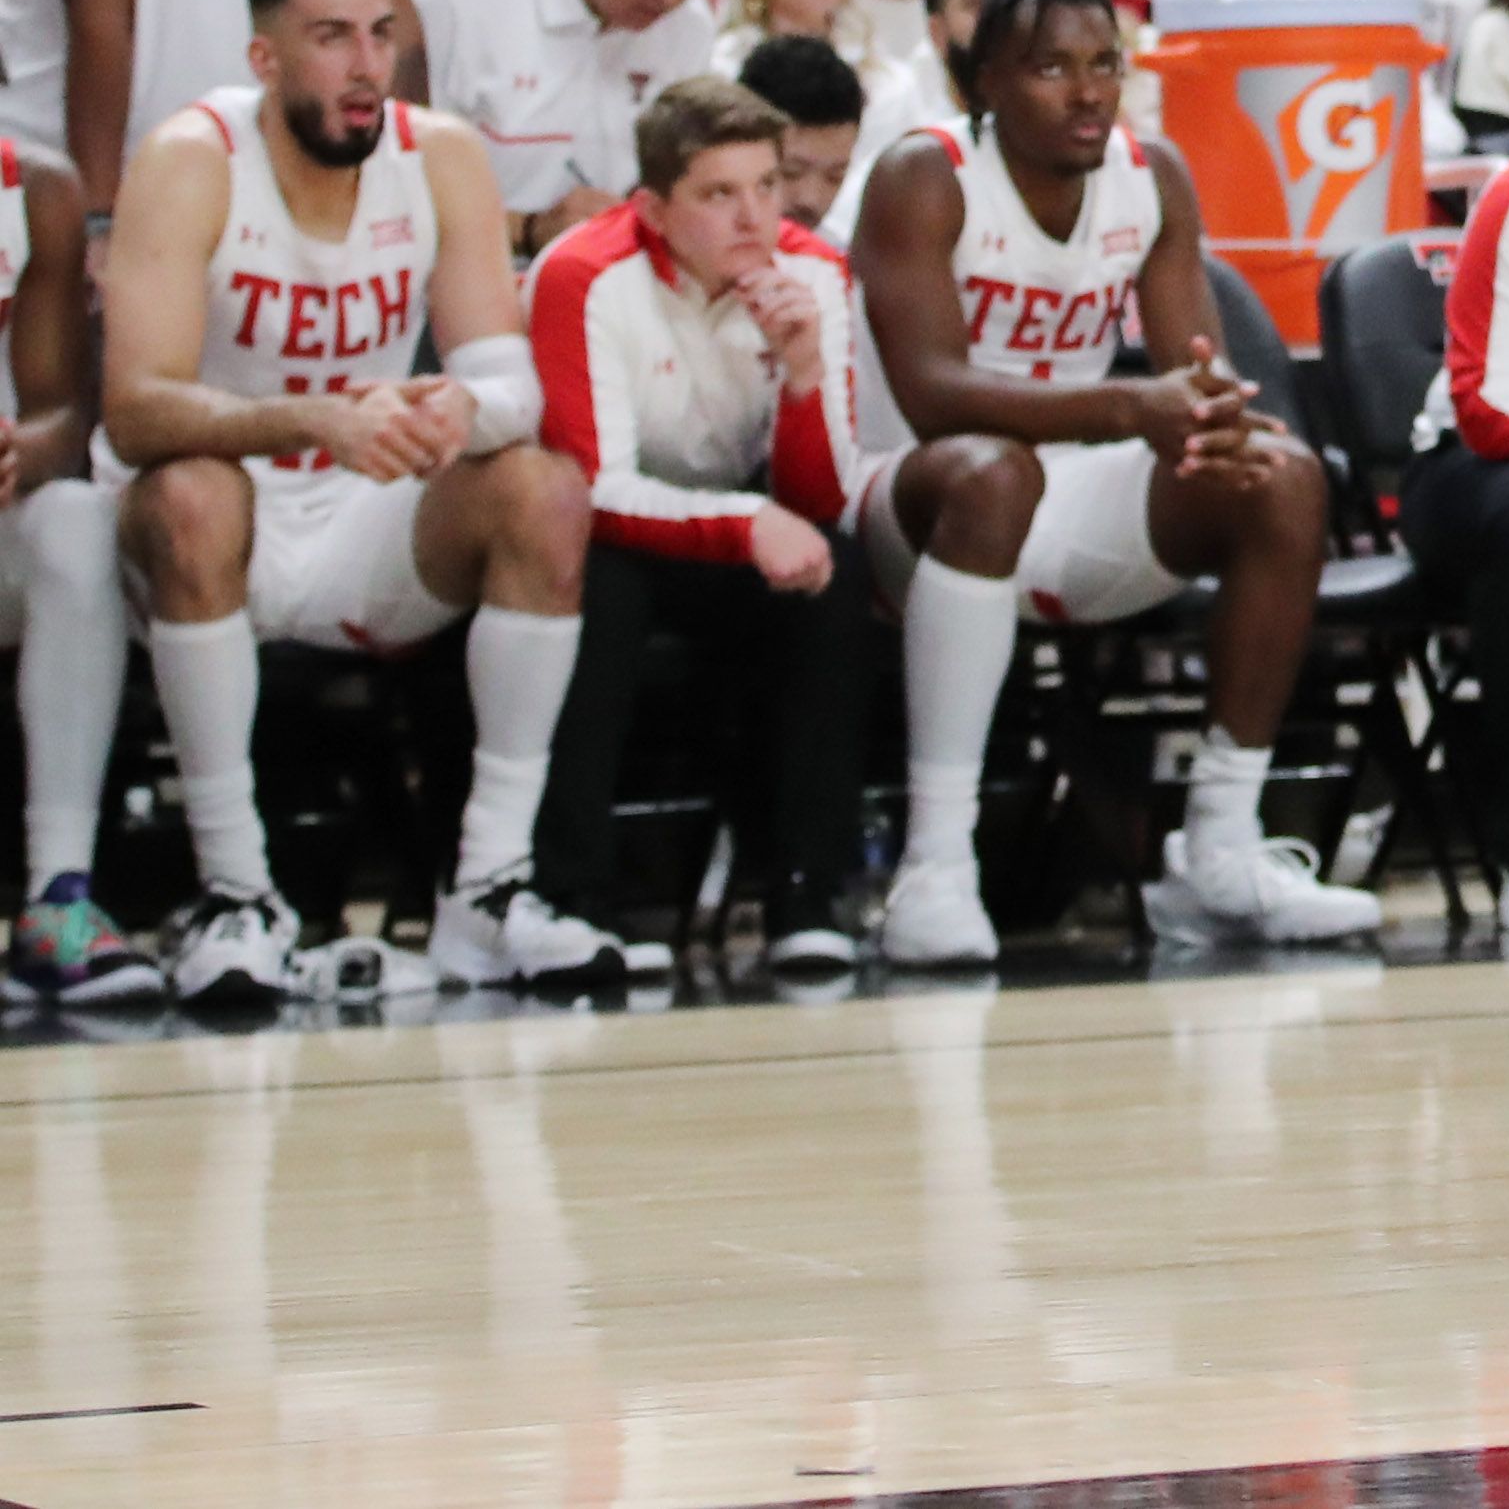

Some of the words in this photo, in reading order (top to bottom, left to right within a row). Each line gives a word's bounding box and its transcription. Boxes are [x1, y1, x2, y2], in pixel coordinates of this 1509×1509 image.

[1297, 79, 1377, 171] G
[230, 267, 412, 359] TECH
[966, 271, 1136, 352] TECH
